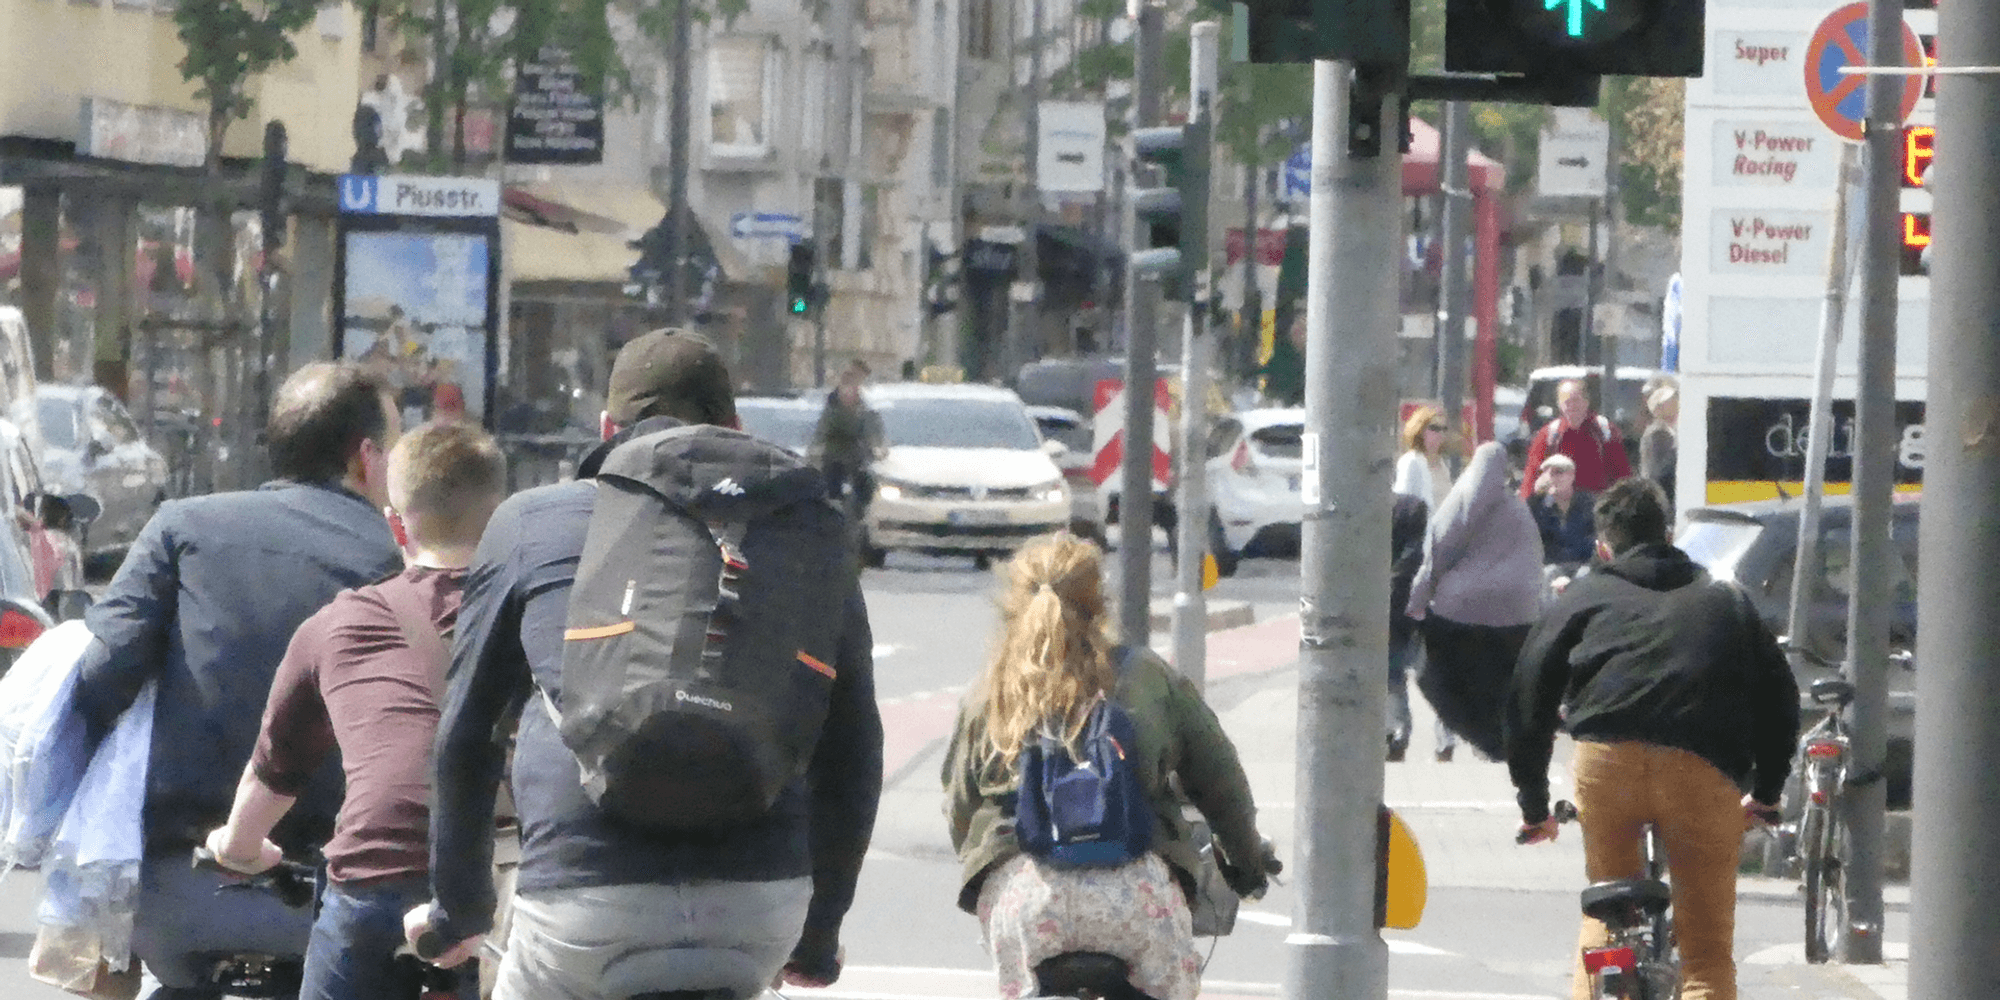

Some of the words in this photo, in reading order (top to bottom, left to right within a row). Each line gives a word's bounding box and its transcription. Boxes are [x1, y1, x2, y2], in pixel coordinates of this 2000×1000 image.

[1735, 37, 1788, 66] Super
[1734, 129, 1815, 151] V-Power
[1733, 153, 1797, 181] Racing
[344, 177, 370, 210] U
[396, 183, 484, 209] Piusstr.
[1731, 217, 1812, 240] V-Power
[1729, 241, 1788, 264] Diesel
